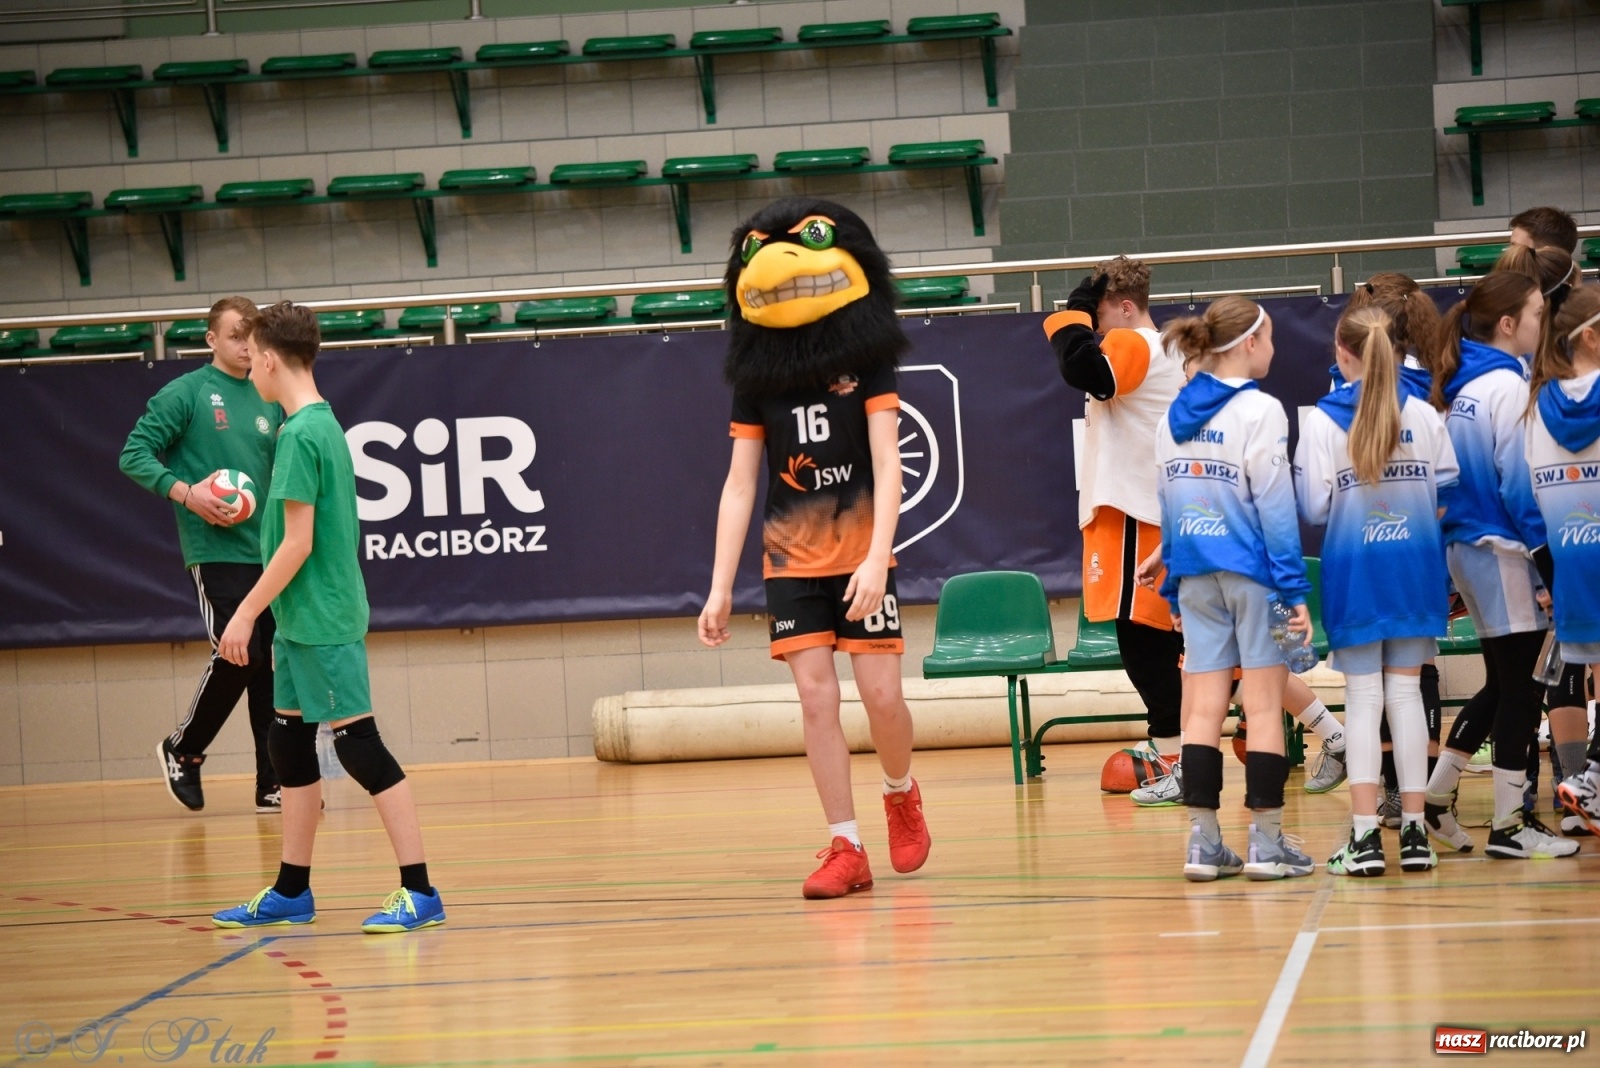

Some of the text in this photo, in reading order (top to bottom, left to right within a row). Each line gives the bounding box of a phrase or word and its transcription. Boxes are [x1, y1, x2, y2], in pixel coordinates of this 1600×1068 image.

[792, 404, 830, 444] 16
[814, 464, 853, 490] JSW
[1535, 468, 1564, 485] SWJ
[365, 519, 548, 560] RACIBÓRZ
[1558, 523, 1600, 548] Wis
[775, 619, 795, 633] JSW
